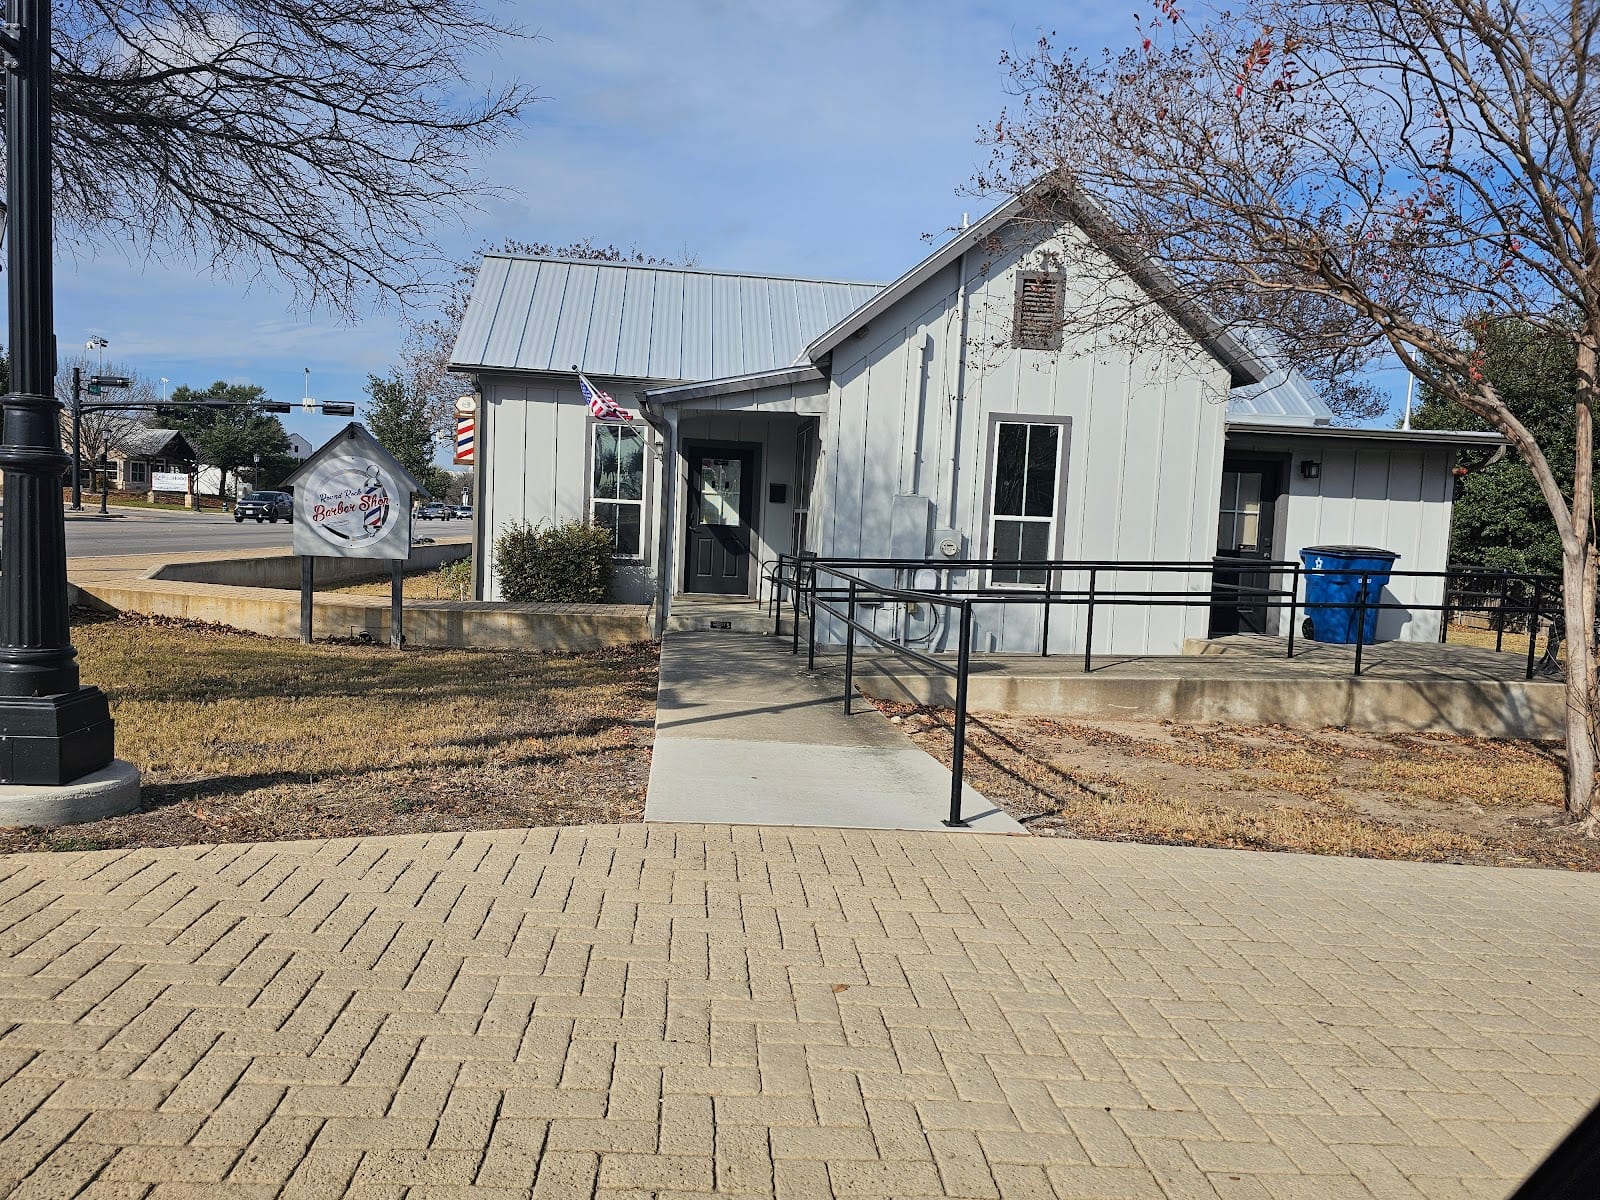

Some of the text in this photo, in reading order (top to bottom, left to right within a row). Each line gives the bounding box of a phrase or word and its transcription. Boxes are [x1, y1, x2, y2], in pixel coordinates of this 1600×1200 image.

[344, 488, 362, 499] Rock
[312, 493, 390, 522] Barber Shop
